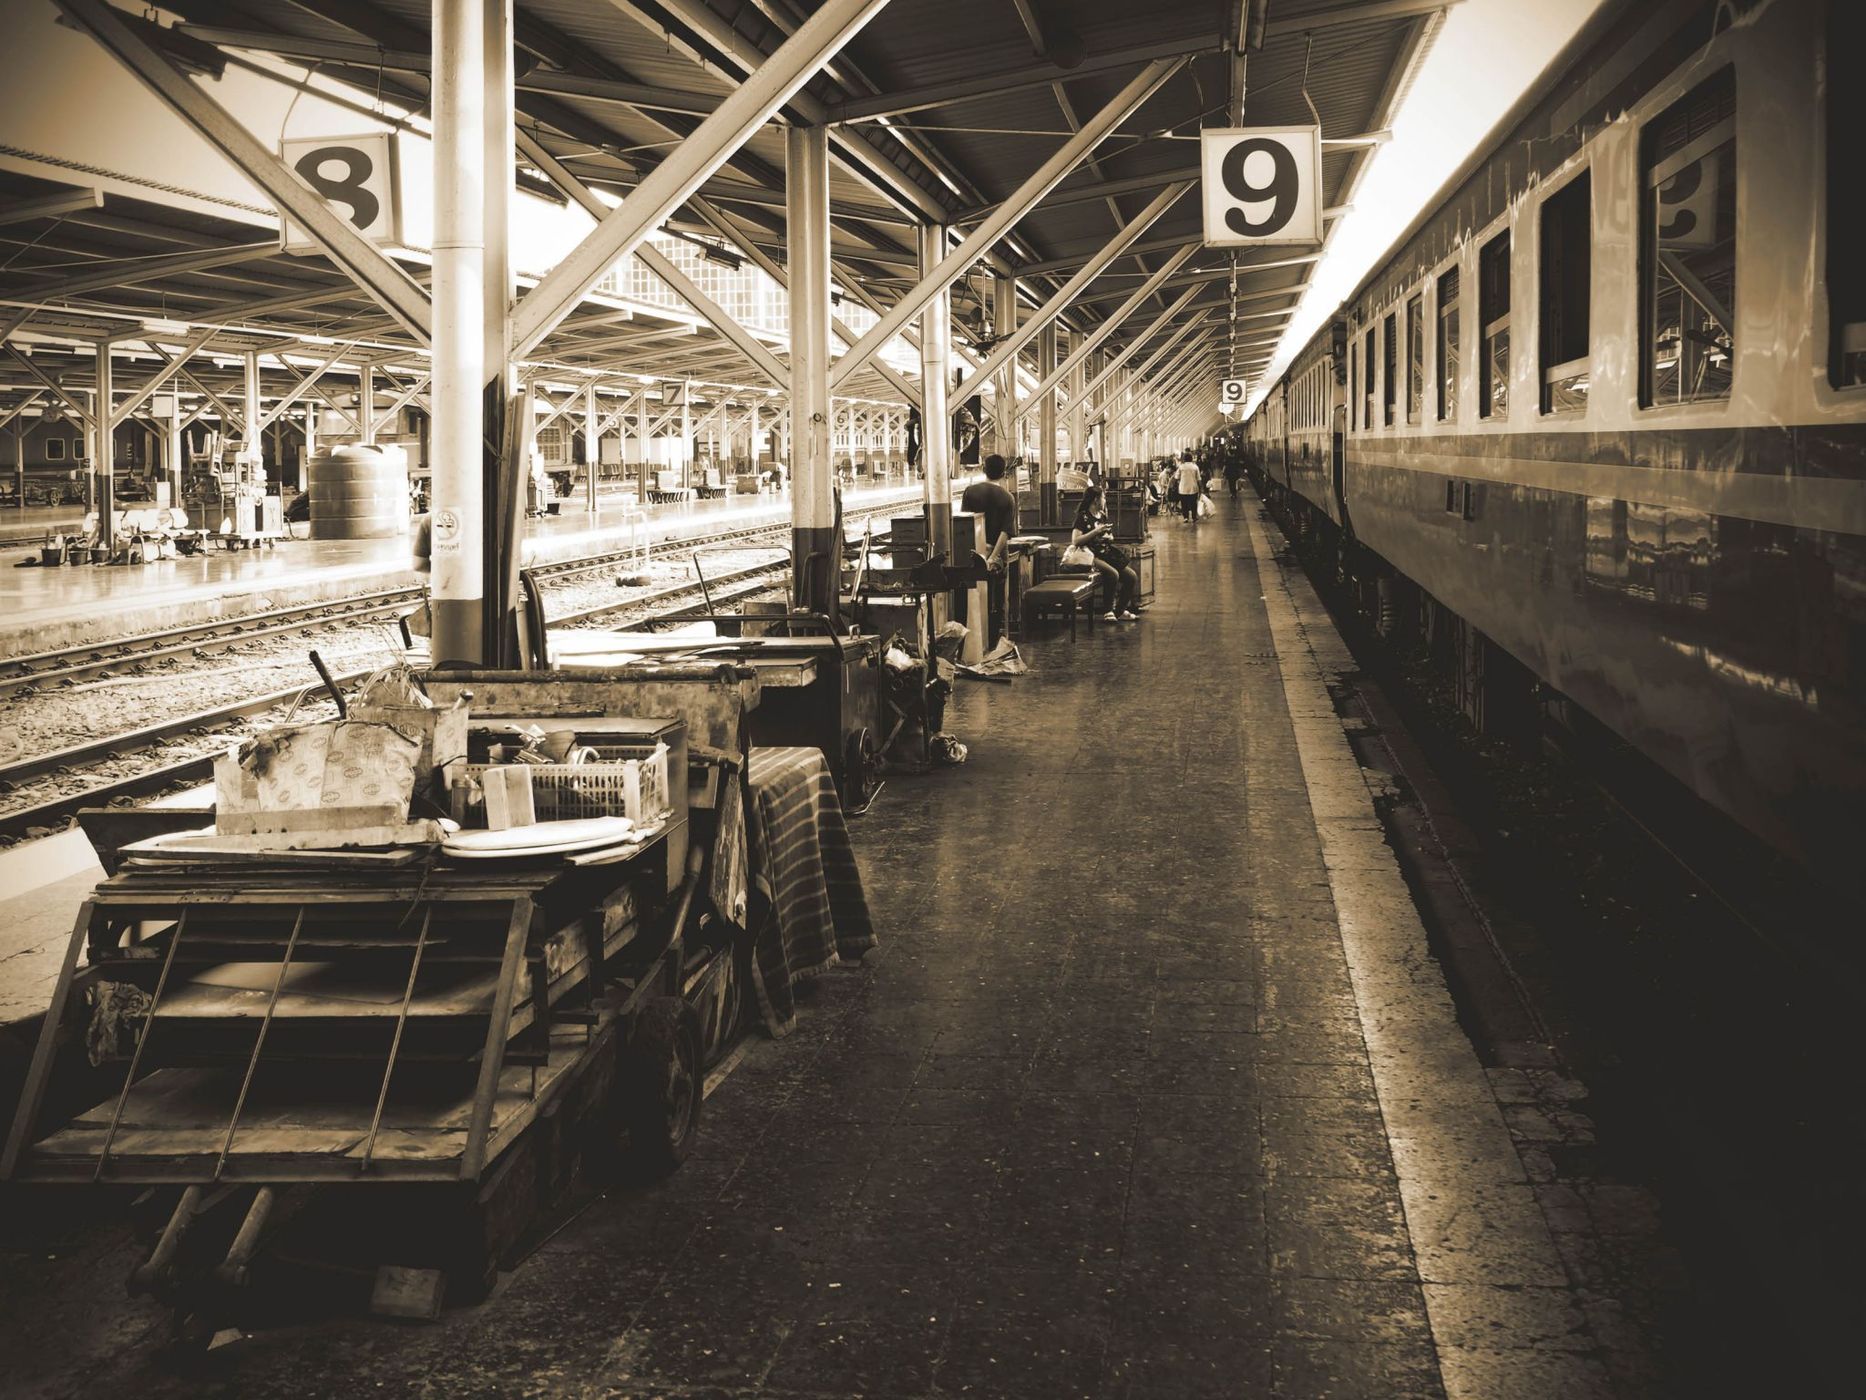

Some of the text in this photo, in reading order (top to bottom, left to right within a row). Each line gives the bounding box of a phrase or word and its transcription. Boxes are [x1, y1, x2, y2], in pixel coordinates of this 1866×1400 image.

[294, 146, 380, 231] 8
[1222, 138, 1299, 237] 9
[666, 386, 682, 403] 7
[1226, 382, 1243, 401] 9
